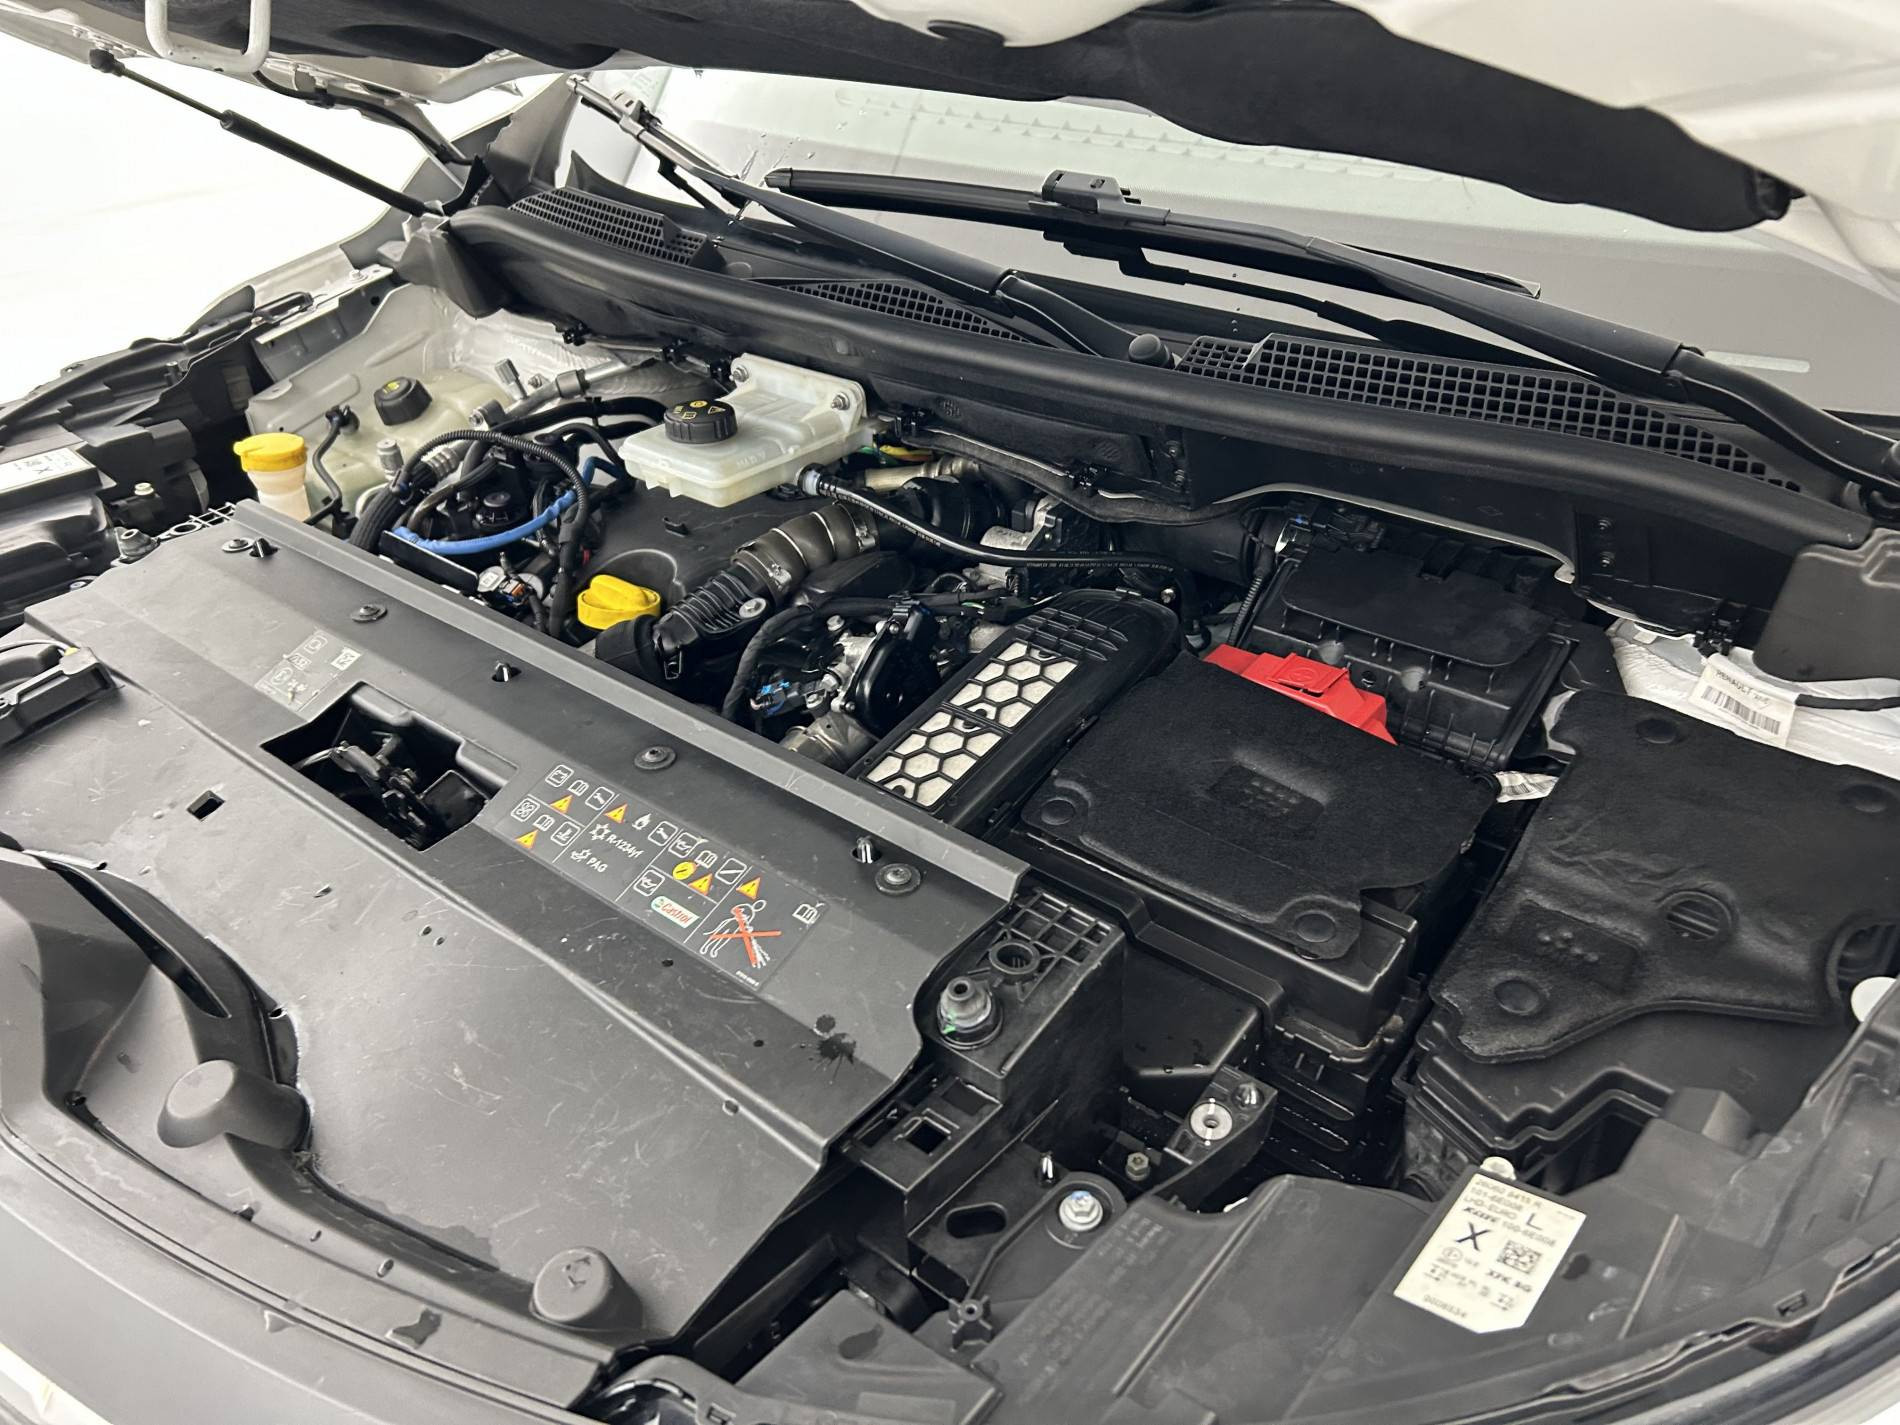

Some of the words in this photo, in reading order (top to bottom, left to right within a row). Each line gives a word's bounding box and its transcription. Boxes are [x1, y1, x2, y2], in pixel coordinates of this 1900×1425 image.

[606, 835, 644, 858] R-1234yf
[587, 856, 608, 873] PAG
[661, 902, 692, 924] Castrol
[1525, 1212, 1543, 1231] L
[1455, 1221, 1490, 1252] X
